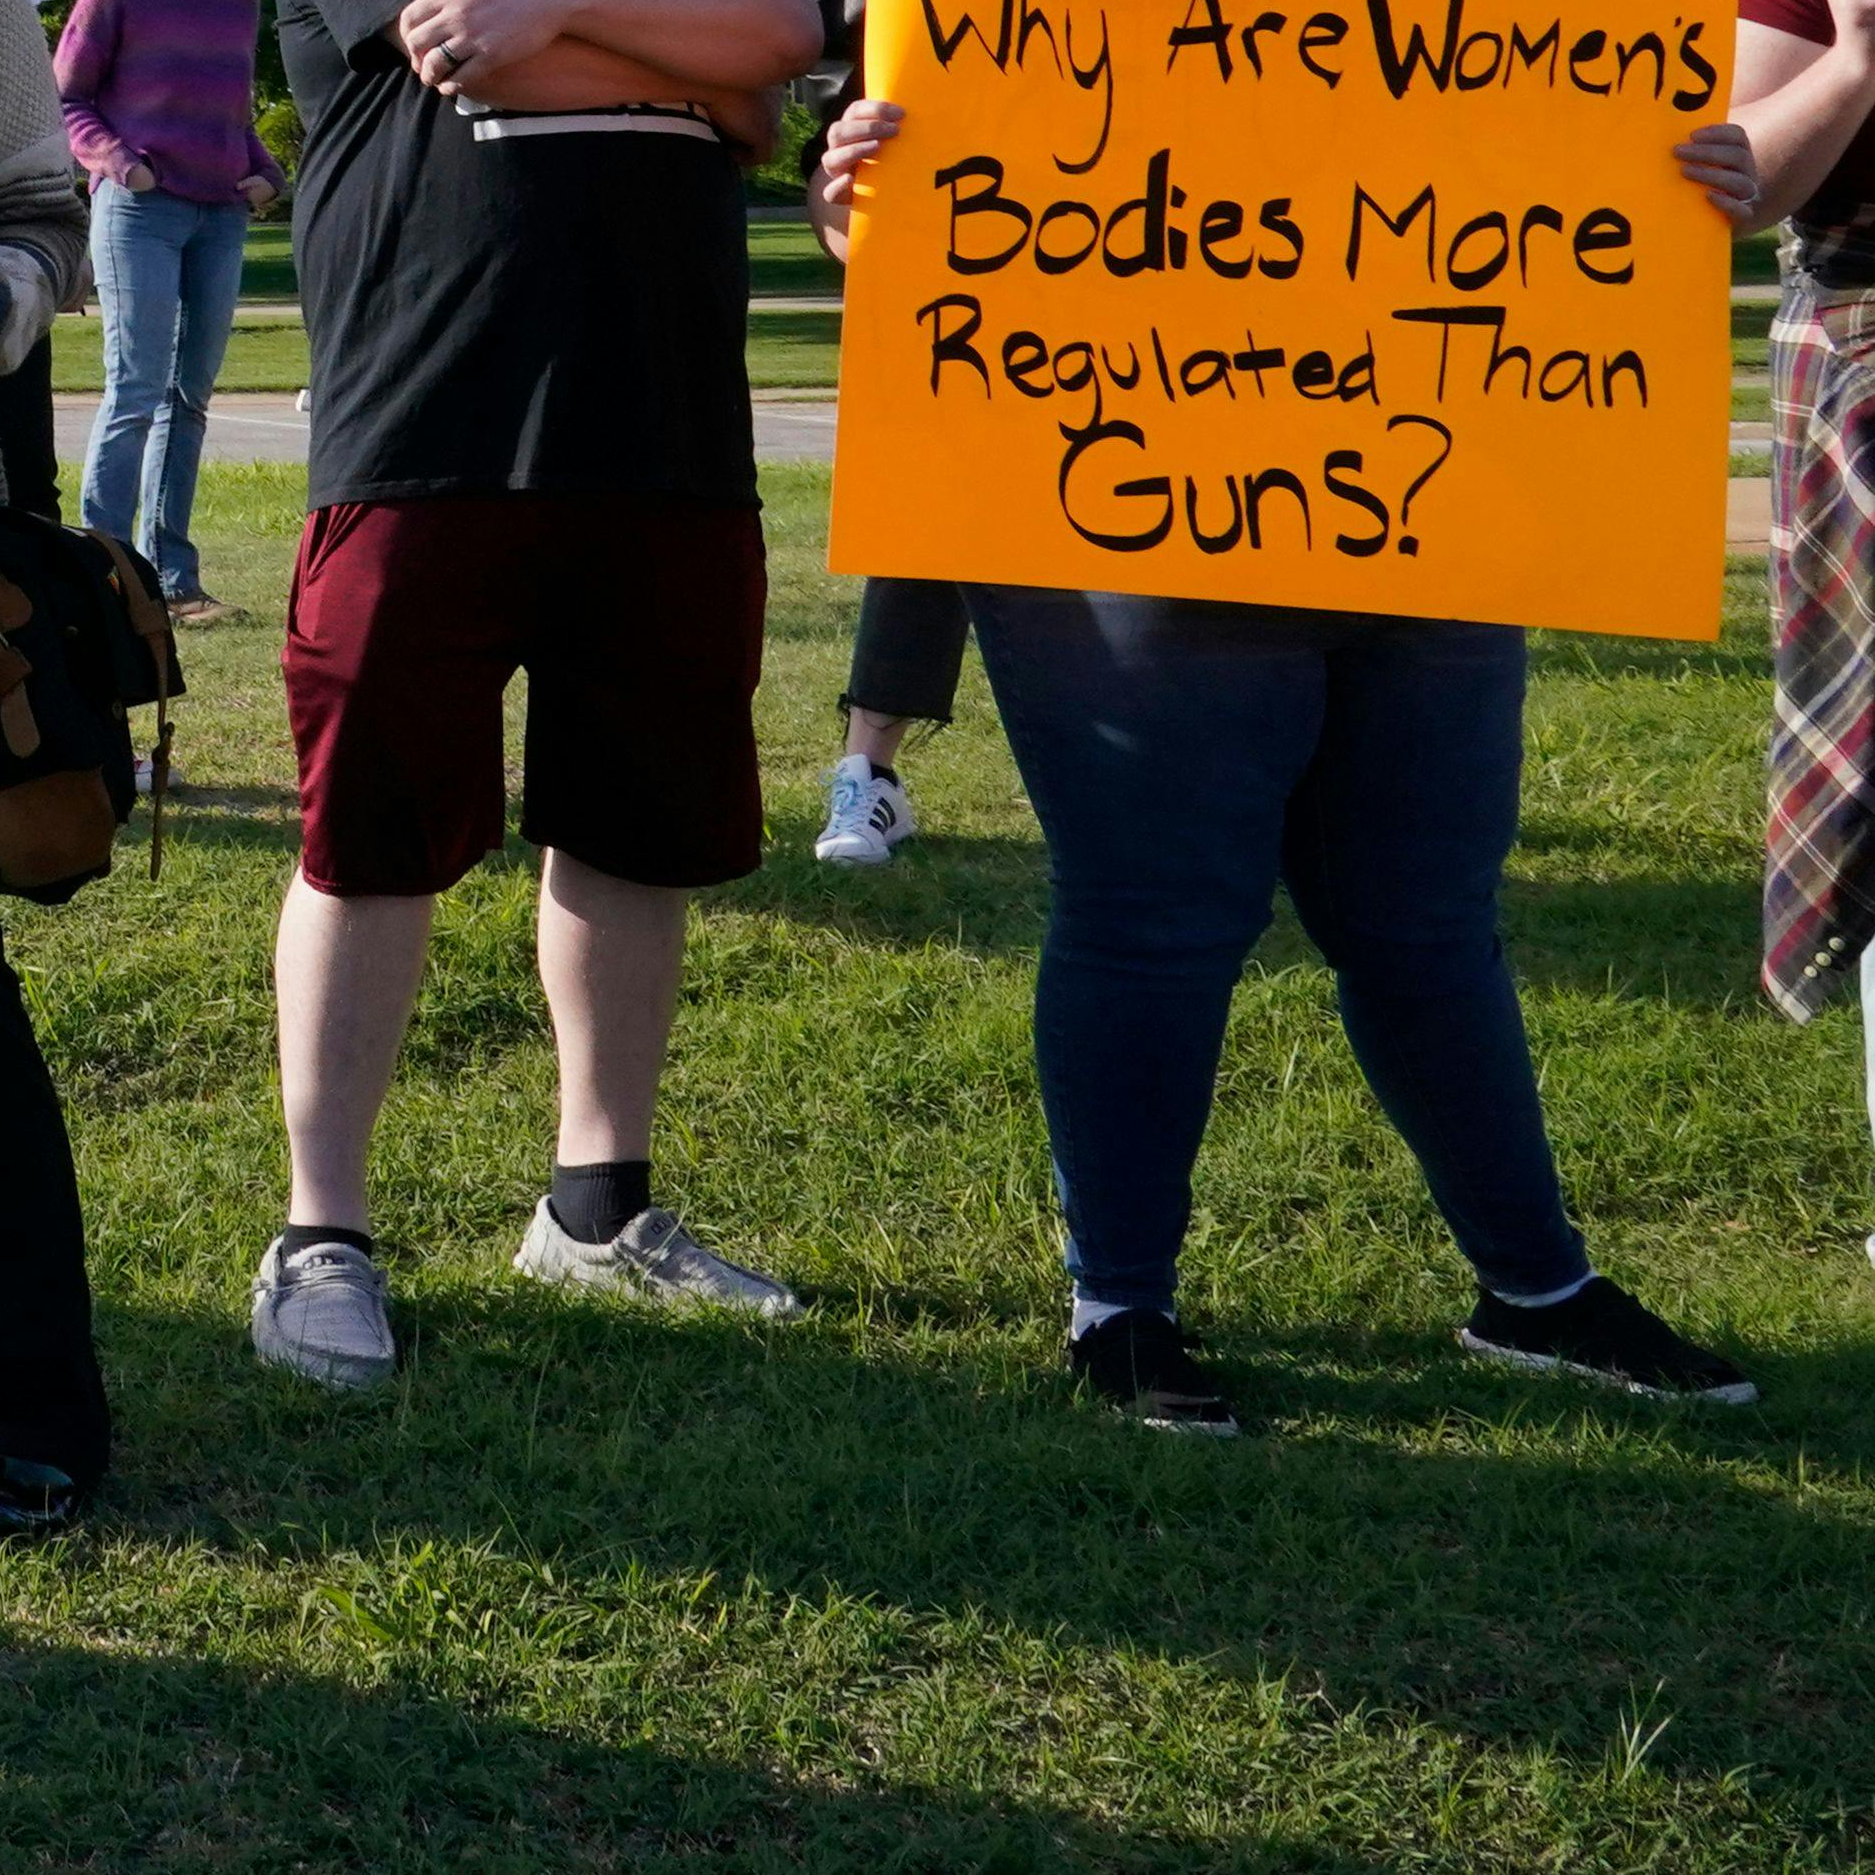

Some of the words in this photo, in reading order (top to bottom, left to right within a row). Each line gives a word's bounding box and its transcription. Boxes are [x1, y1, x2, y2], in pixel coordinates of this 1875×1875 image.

[935, 148, 1305, 280] Bodies
[1345, 183, 1635, 290] More
[916, 293, 1381, 443] Regulated
[1391, 305, 1648, 410] Than
[1058, 414, 1453, 558] Guns?
